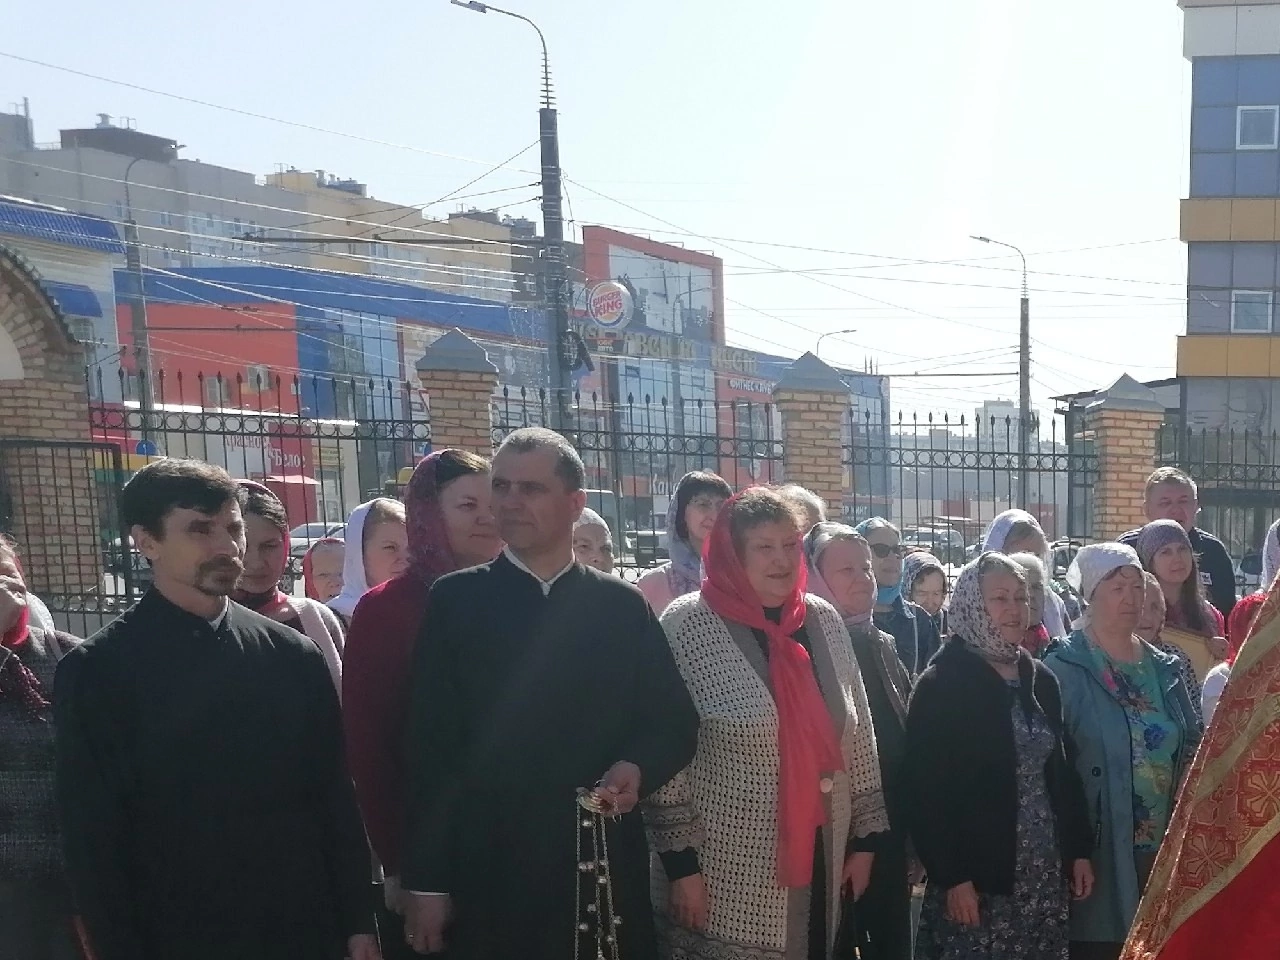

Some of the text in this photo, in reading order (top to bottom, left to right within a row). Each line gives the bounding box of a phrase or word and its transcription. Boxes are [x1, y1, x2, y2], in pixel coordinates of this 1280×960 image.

[592, 290, 622, 308] BURGER
[594, 300, 623, 318] KING
[274, 447, 306, 468] Белое
